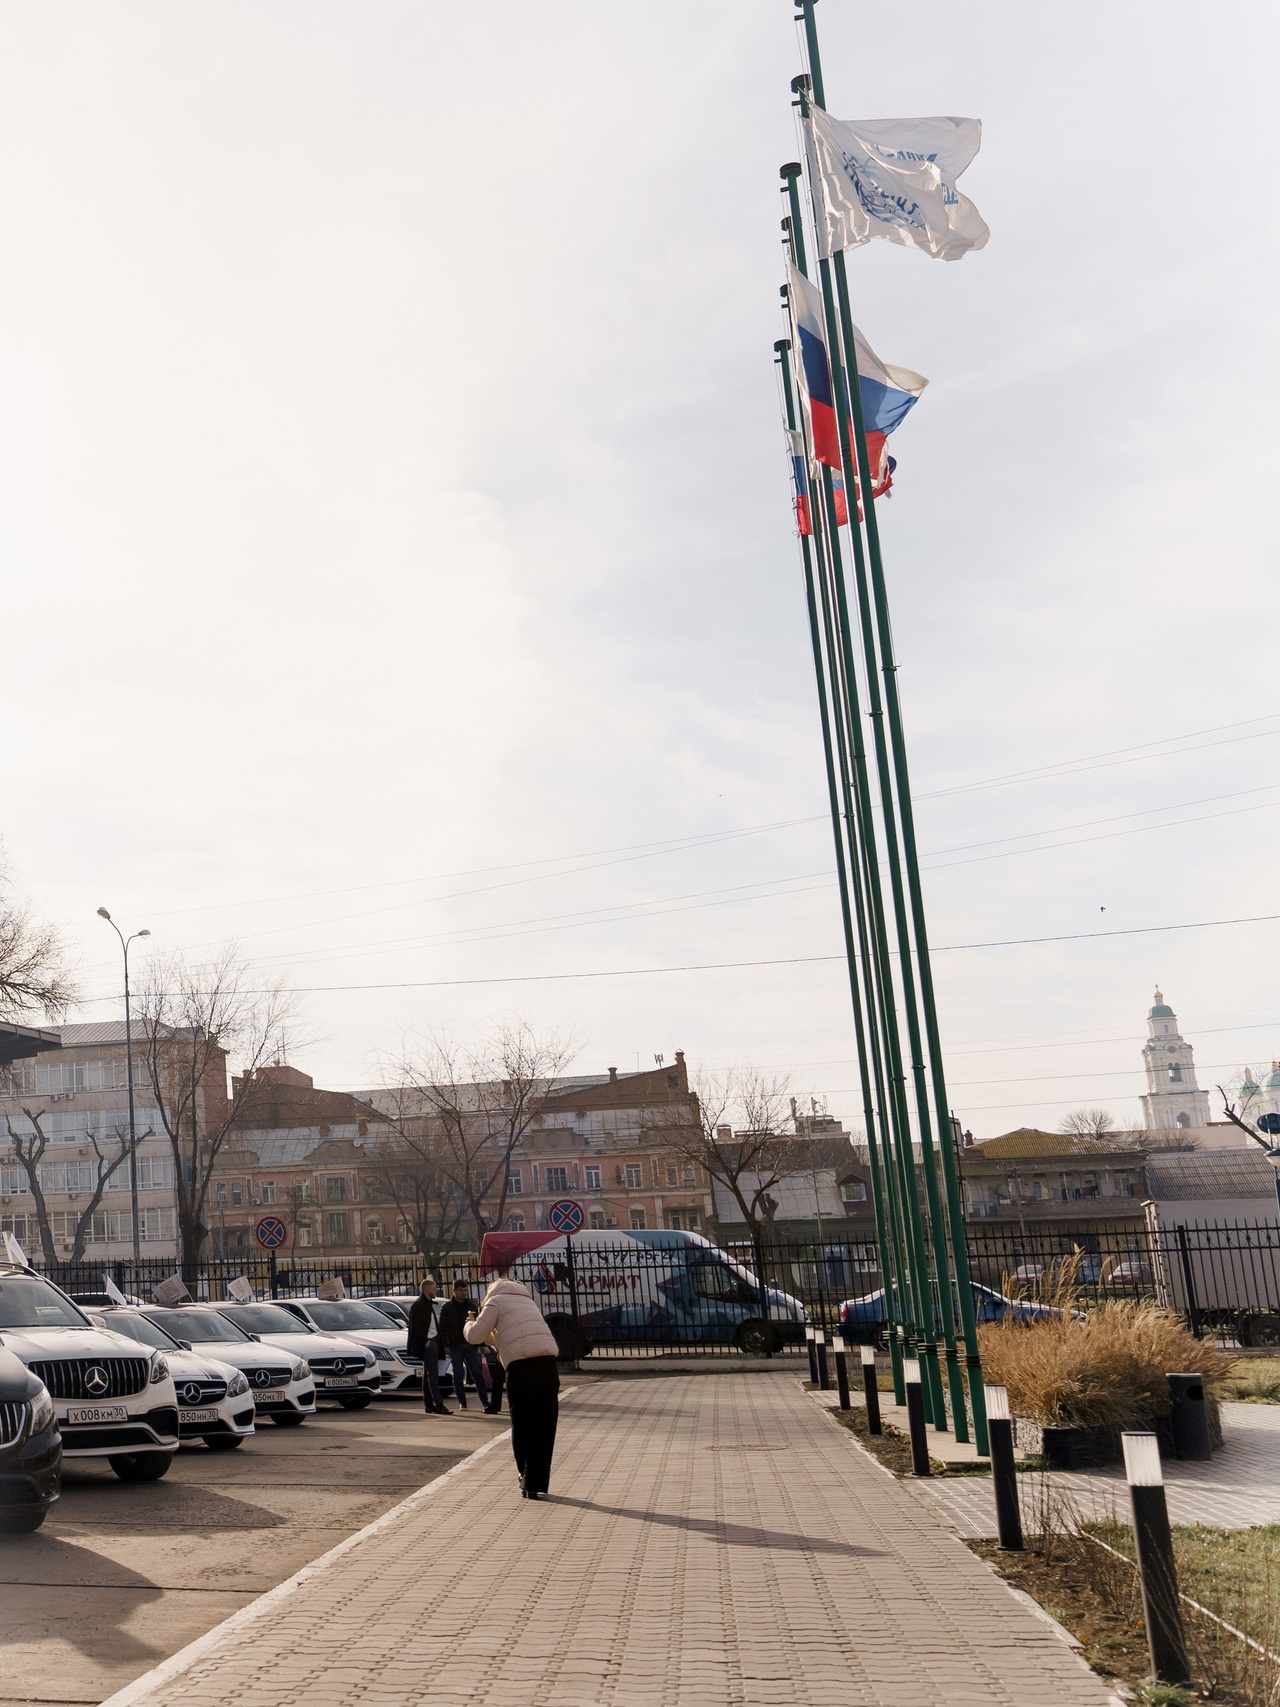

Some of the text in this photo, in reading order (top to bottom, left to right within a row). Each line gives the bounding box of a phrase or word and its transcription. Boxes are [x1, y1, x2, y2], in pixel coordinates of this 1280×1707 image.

[254, 1393, 275, 1401] 050МХ
[73, 1406, 124, 1422] Х008КМ 30
[180, 1410, 216, 1421] 850НН 30
